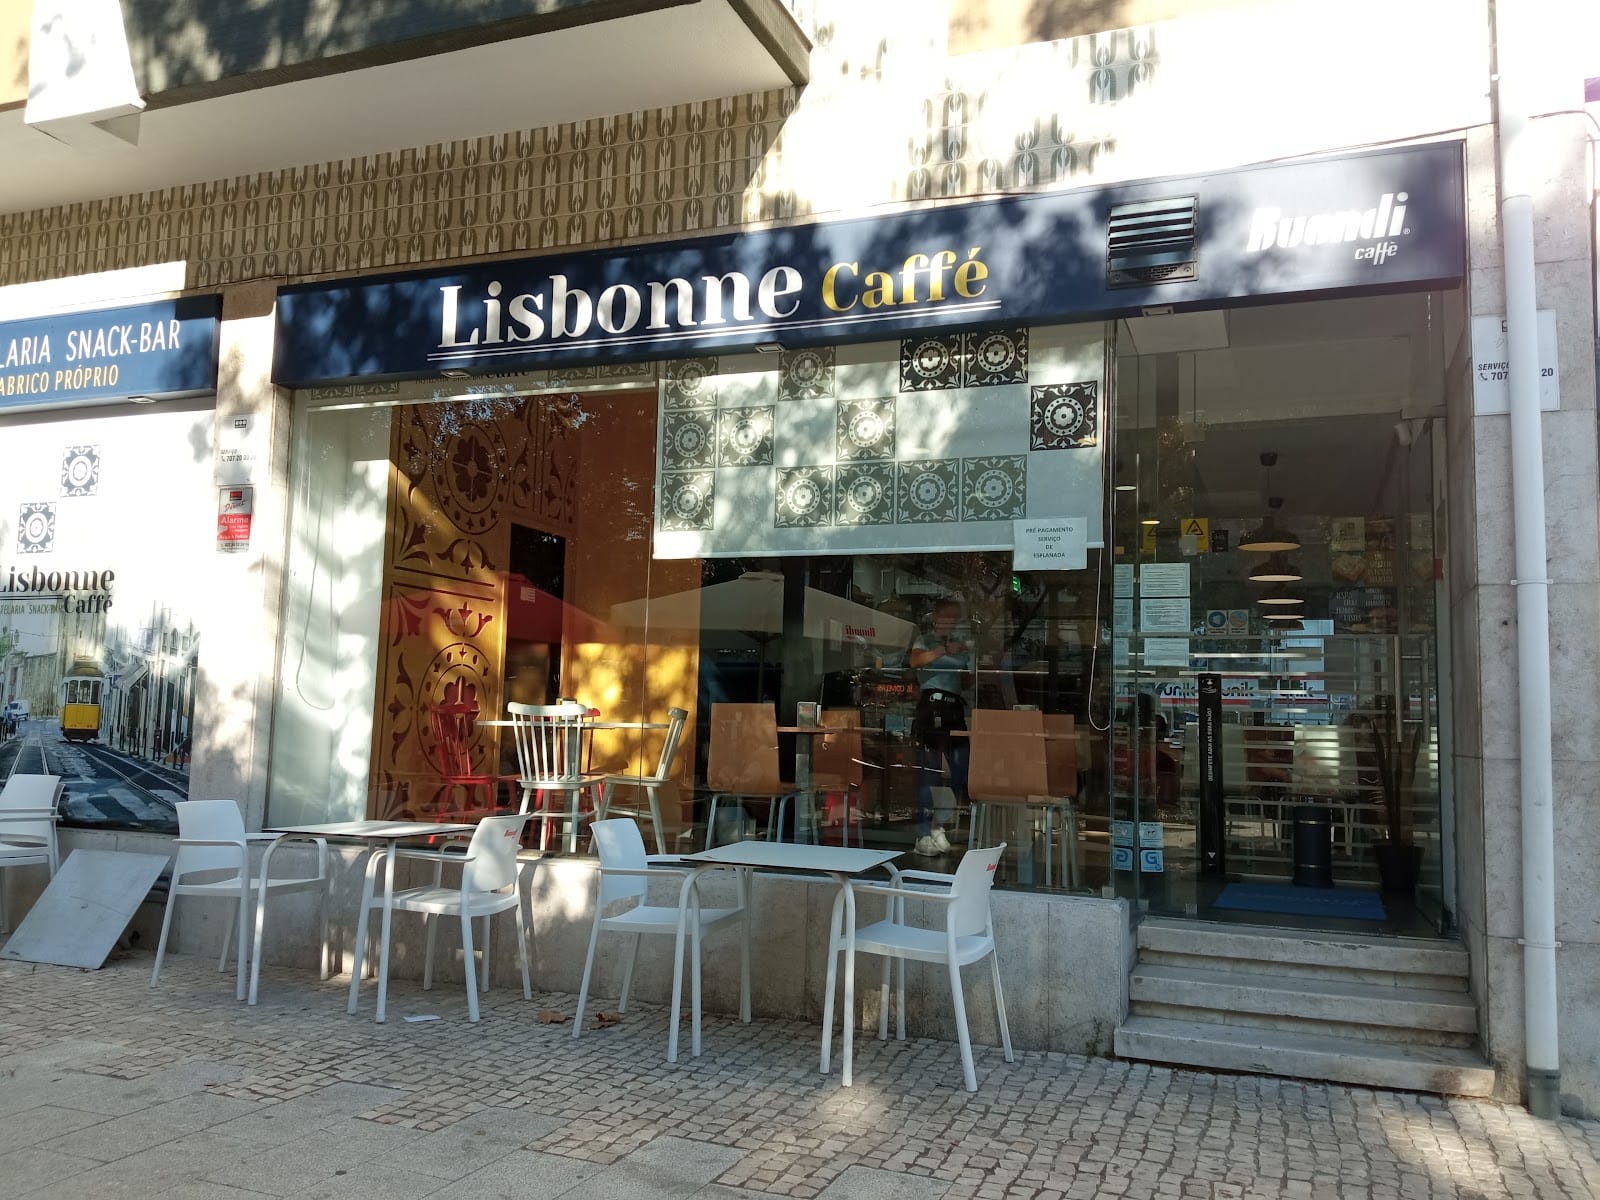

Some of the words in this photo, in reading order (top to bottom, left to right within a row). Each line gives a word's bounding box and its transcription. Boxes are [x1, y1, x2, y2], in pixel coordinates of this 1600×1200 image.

[437, 266, 804, 349] Lisbonne
[821, 247, 990, 313] Caffé
[65, 319, 181, 362] SNACK-BAR
[54, 364, 120, 391] PRÓPRIO
[1490, 371, 1509, 381] 707
[1541, 367, 1554, 377] 20
[64, 594, 113, 614] Caffé
